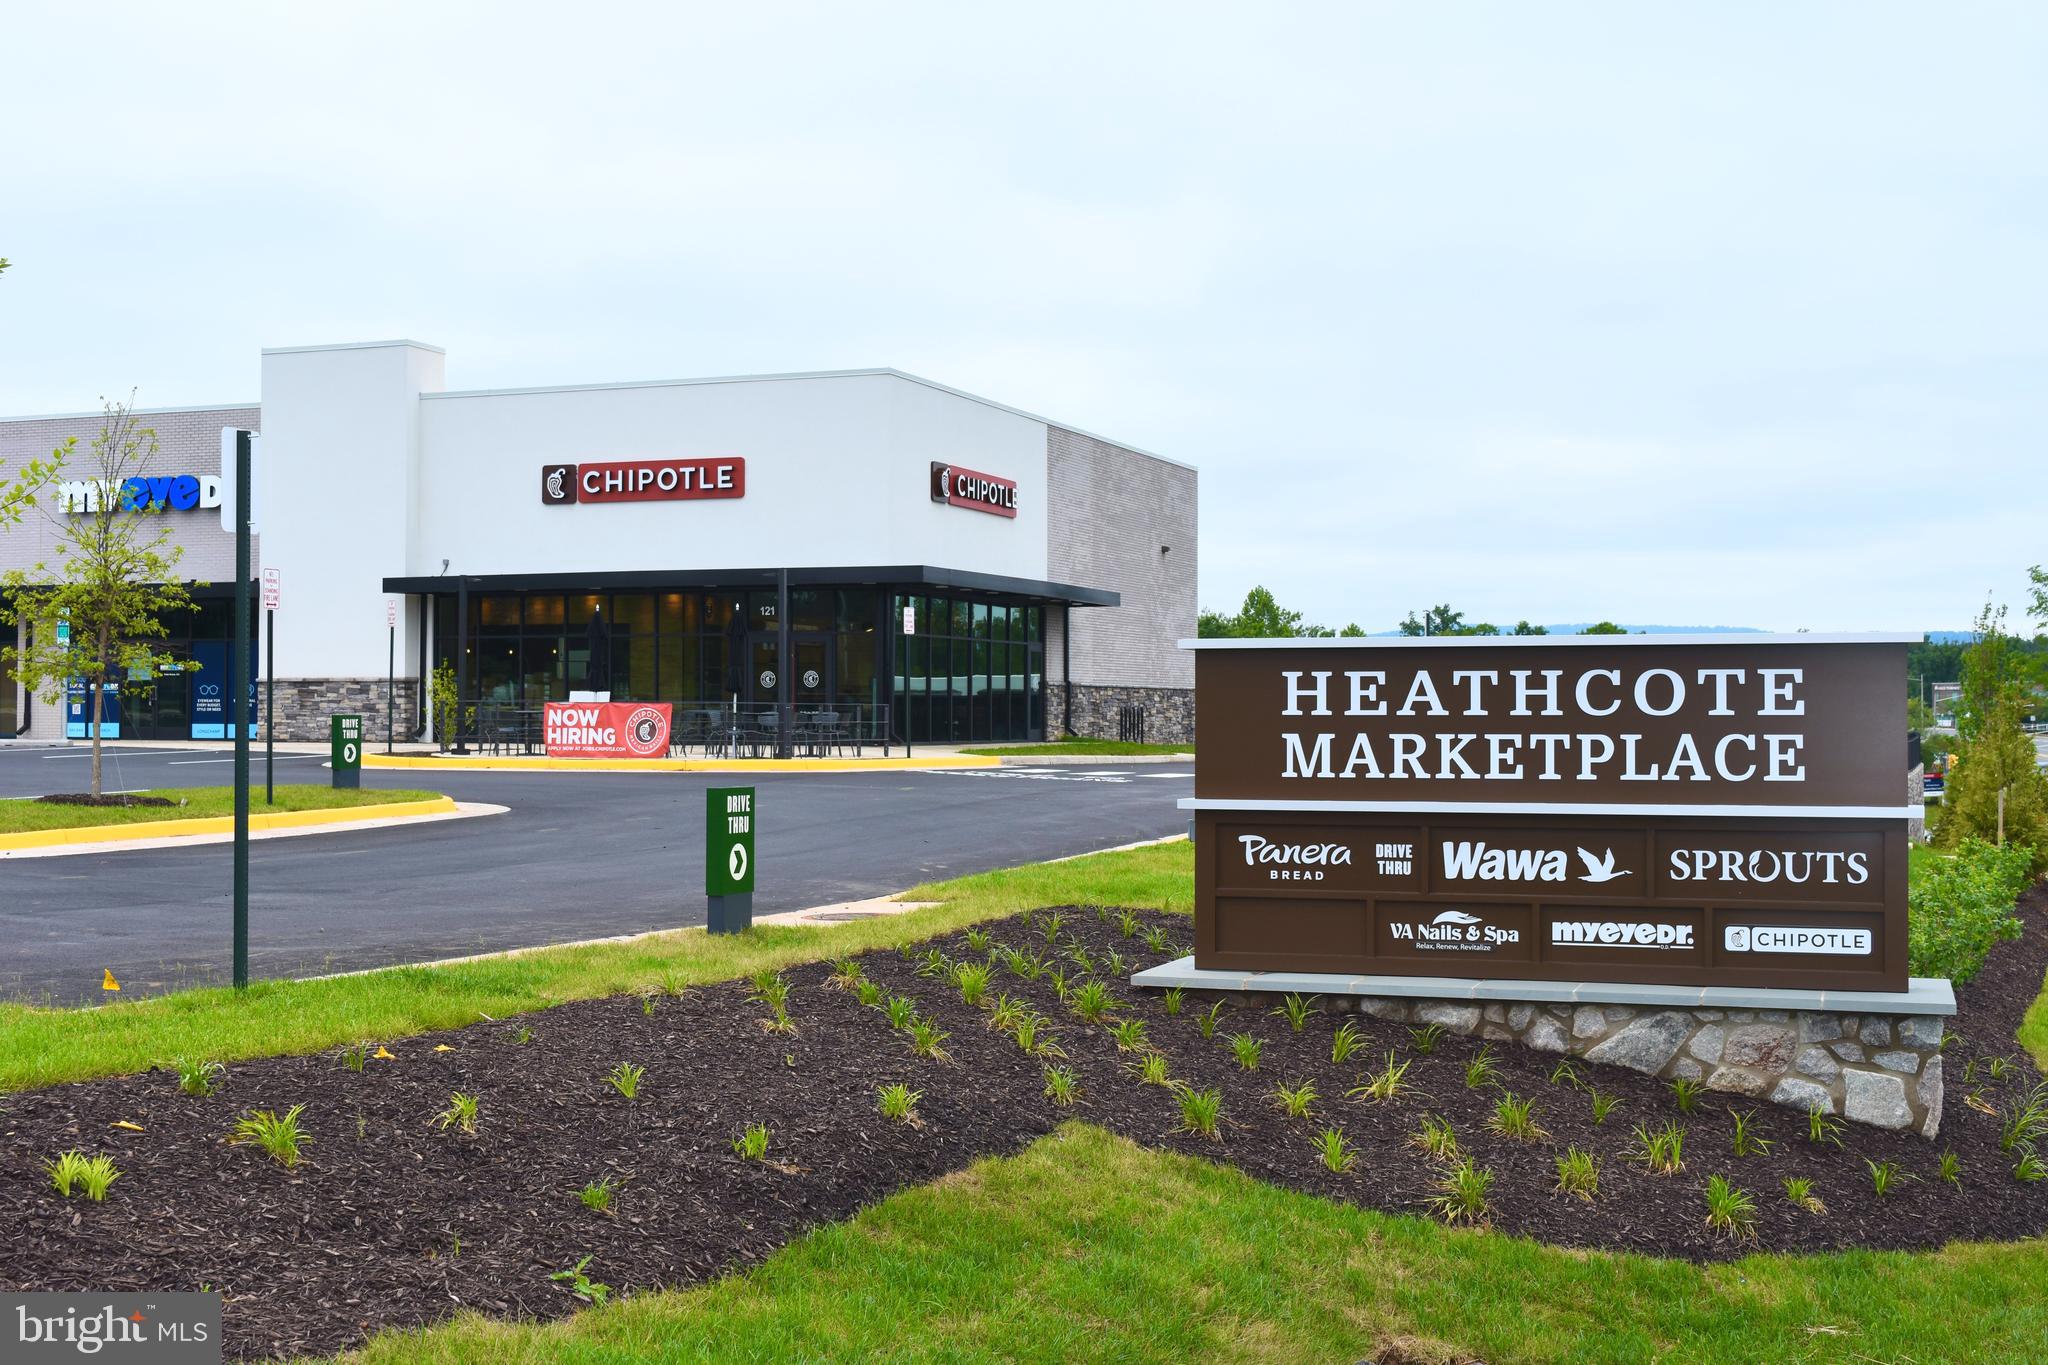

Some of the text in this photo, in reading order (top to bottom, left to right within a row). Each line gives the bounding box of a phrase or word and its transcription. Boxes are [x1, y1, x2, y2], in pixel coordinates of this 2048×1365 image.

[583, 465, 734, 494] CHIPOTLE
[957, 474, 1018, 508] CHIPOTLE
[760, 606, 775, 616] 121
[1281, 668, 1805, 717] HEATHCOTE
[342, 718, 359, 728] DRIVE
[547, 709, 600, 726] NOW
[630, 710, 664, 728] CHIPOTLE
[343, 729, 358, 739] THRU
[547, 727, 616, 745] HIRING
[1281, 732, 1806, 782] MARKETPLACE
[727, 794, 751, 813] DRIVE
[728, 815, 750, 834] THRU
[1238, 835, 1351, 865] Panera
[1375, 843, 1413, 858] DRIVE
[1377, 860, 1412, 875] THRU
[1442, 841, 1568, 881] Wawa
[1669, 849, 1870, 884] SPROUTS
[1270, 869, 1325, 881] BREAD
[1390, 923, 1520, 946] VA Nails & Spa
[1757, 932, 1865, 949] CHIPOTLE
[1416, 942, 1492, 952] Relax, Renew, Revitalize
